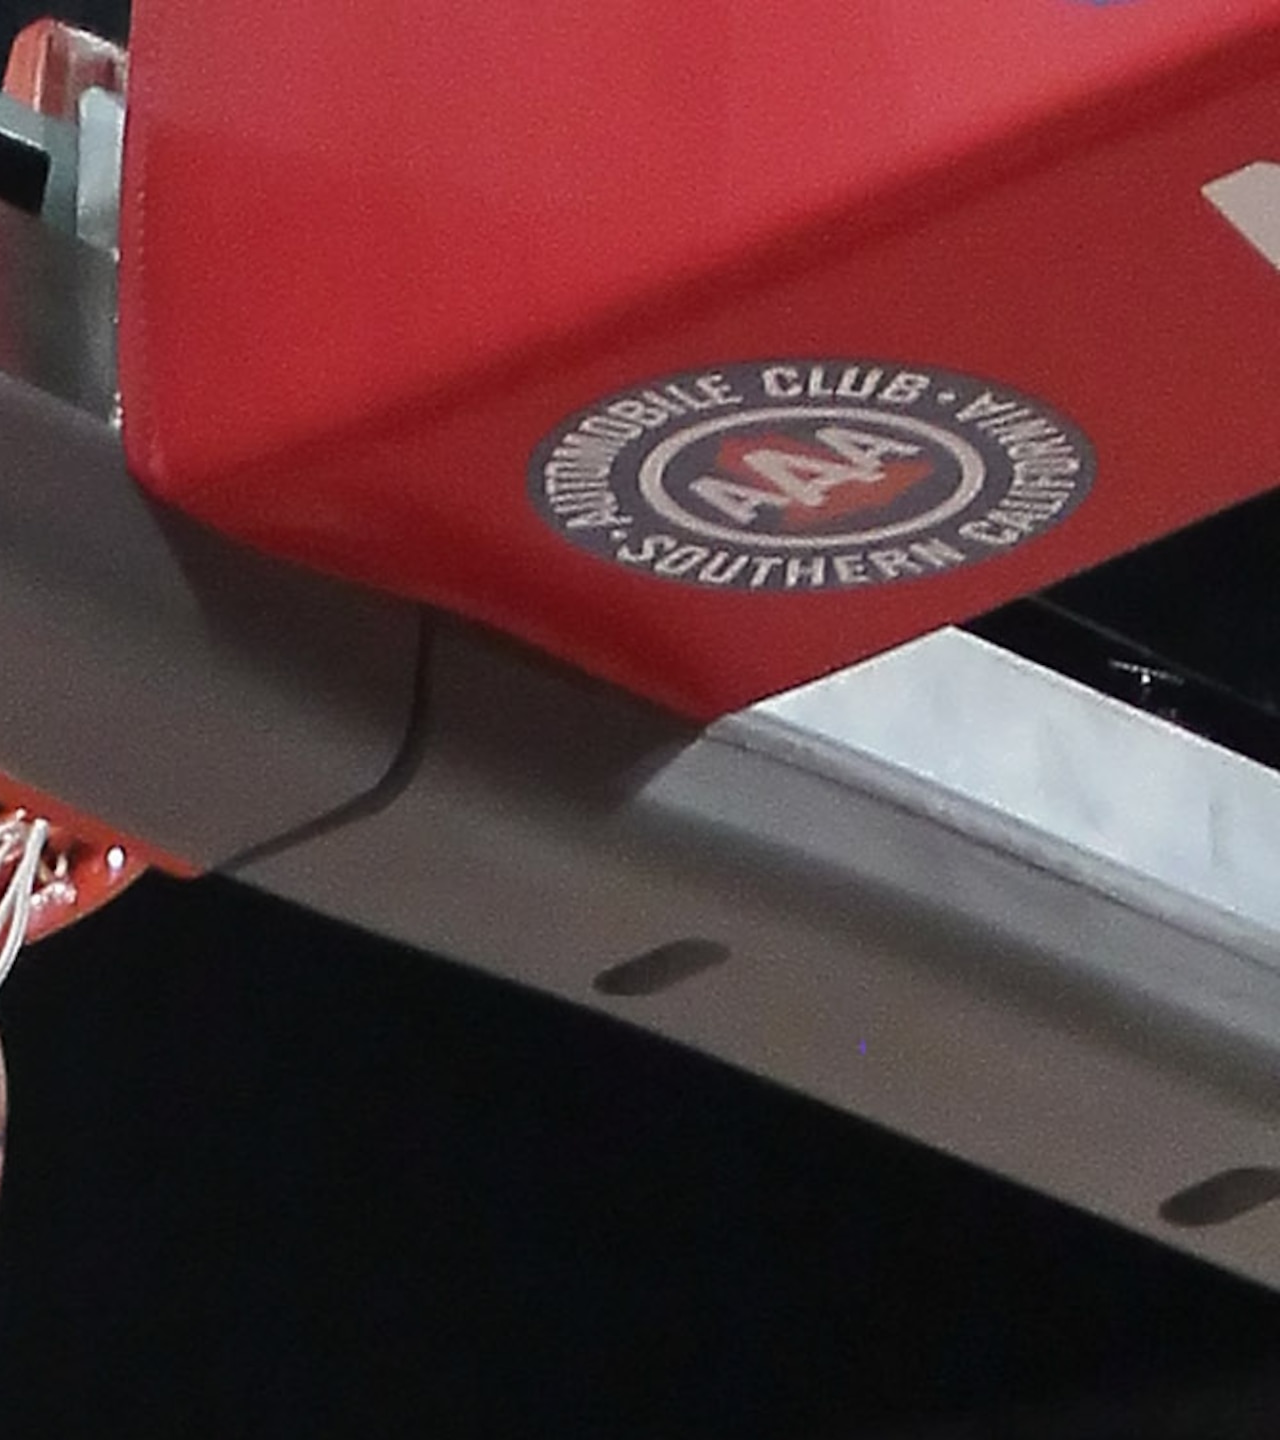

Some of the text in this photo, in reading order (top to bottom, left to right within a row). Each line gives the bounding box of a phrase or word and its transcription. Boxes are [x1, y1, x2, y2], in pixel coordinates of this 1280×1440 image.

[544, 365, 931, 529] AUTOMOBILE CLUB
[617, 391, 1080, 588] SOUTHERN CALIFORNIA
[687, 424, 921, 526] AAA
